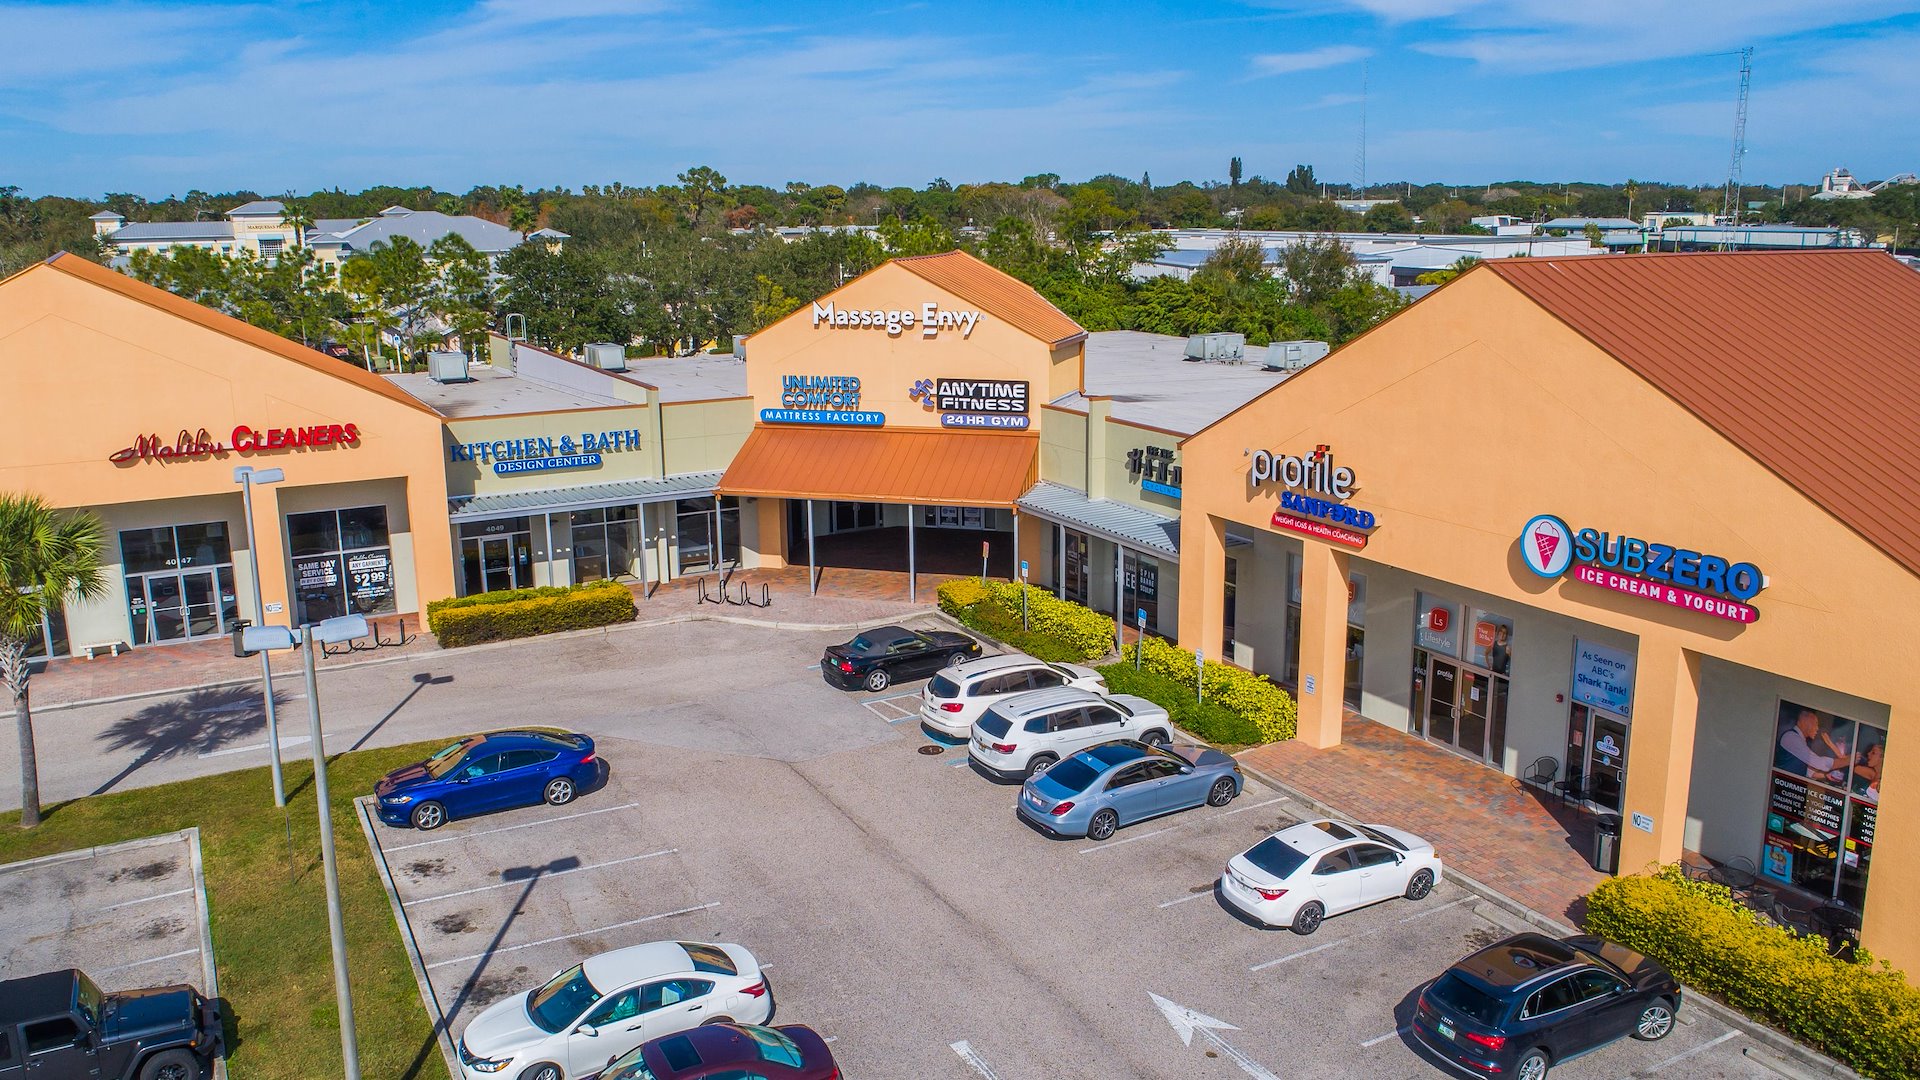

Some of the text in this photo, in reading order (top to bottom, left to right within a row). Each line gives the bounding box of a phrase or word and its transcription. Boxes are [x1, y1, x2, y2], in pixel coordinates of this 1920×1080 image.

[813, 301, 980, 337] Massage Envy
[782, 375, 860, 392] UNLIMITED
[939, 382, 1025, 398] ANYTIME
[782, 391, 860, 408] COMFORT
[765, 411, 880, 423] MATTRESS FACTORY
[946, 415, 1024, 426] 24 HR GYM
[109, 424, 357, 468] Malibu CLEANERS
[450, 428, 640, 462] KITCHEN & BATH
[498, 455, 597, 472] DESIGN CENTER
[1252, 446, 1354, 499] profile
[1281, 491, 1375, 529] SANFORD
[1275, 515, 1295, 526] WEIGHT
[1295, 520, 1308, 530] LOSS
[1313, 526, 1332, 536] HEALTH
[1333, 531, 1363, 544] COACHING
[298, 560, 336, 570] SAME DAY
[302, 568, 334, 577] SERVICE
[1575, 528, 1759, 600] SUBZERO
[1581, 568, 1749, 621] ICE CREAM & YOGURT
[1434, 614, 1443, 626] Ls
[1425, 632, 1451, 648] Lifestyle
[1582, 651, 1592, 660] As
[1594, 654, 1613, 667] Seen
[1592, 666, 1614, 679] ABC's
[1578, 673, 1626, 696] Shark Tank!
[1775, 778, 1807, 794] GOURMET
[1819, 794, 1842, 806] CREAM
[1782, 790, 1832, 811] CUSTARD YOGURT
[1773, 794, 1792, 805] ITALIAN
[1809, 807, 1839, 822] SMOOTHIES
[1632, 813, 1641, 826] NO
[1807, 814, 1826, 824] CREAM
